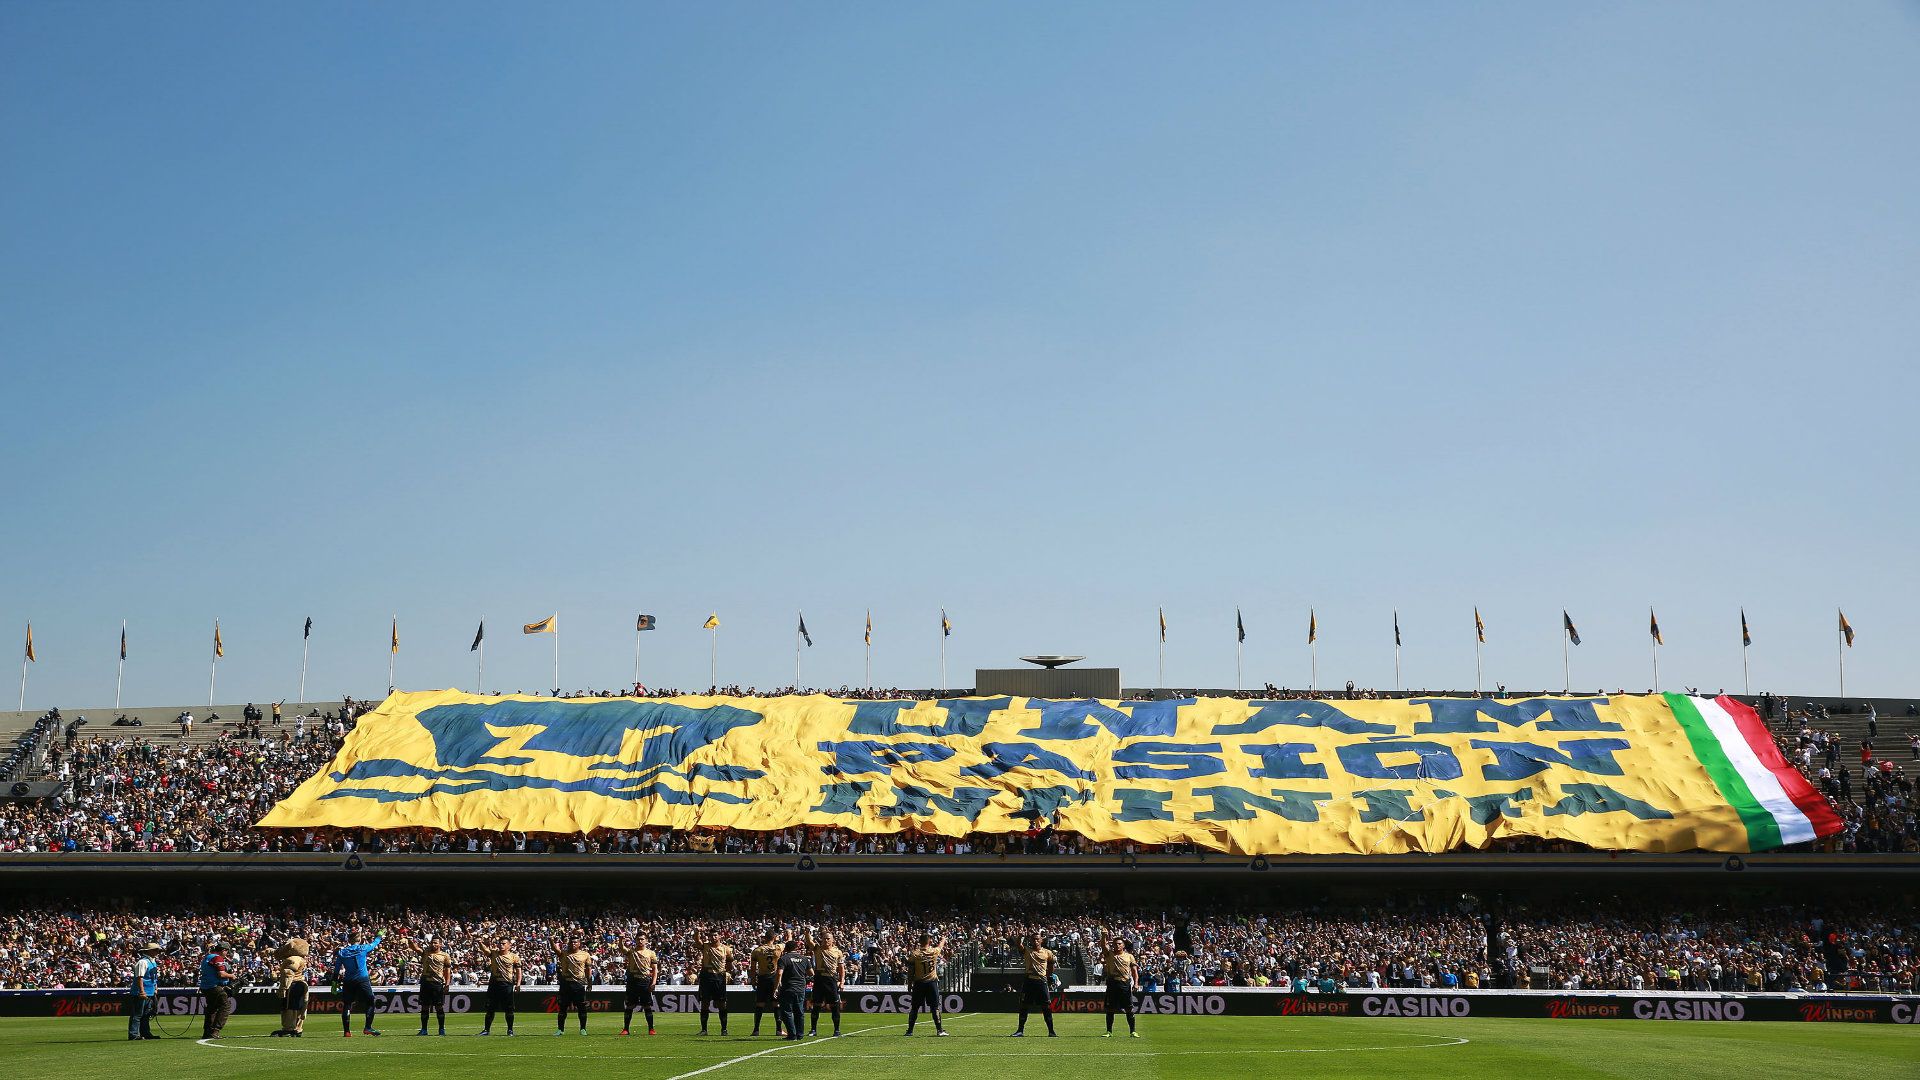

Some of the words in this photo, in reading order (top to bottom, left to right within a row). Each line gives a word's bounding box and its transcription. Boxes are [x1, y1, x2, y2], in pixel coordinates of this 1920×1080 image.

[843, 697, 1625, 740] UNAM
[156, 996, 237, 1014] ASIN
[374, 995, 471, 1013] CASO
[860, 995, 964, 1013] CASO
[1363, 996, 1470, 1017] CASINO
[1633, 1000, 1745, 1021] CASINO
